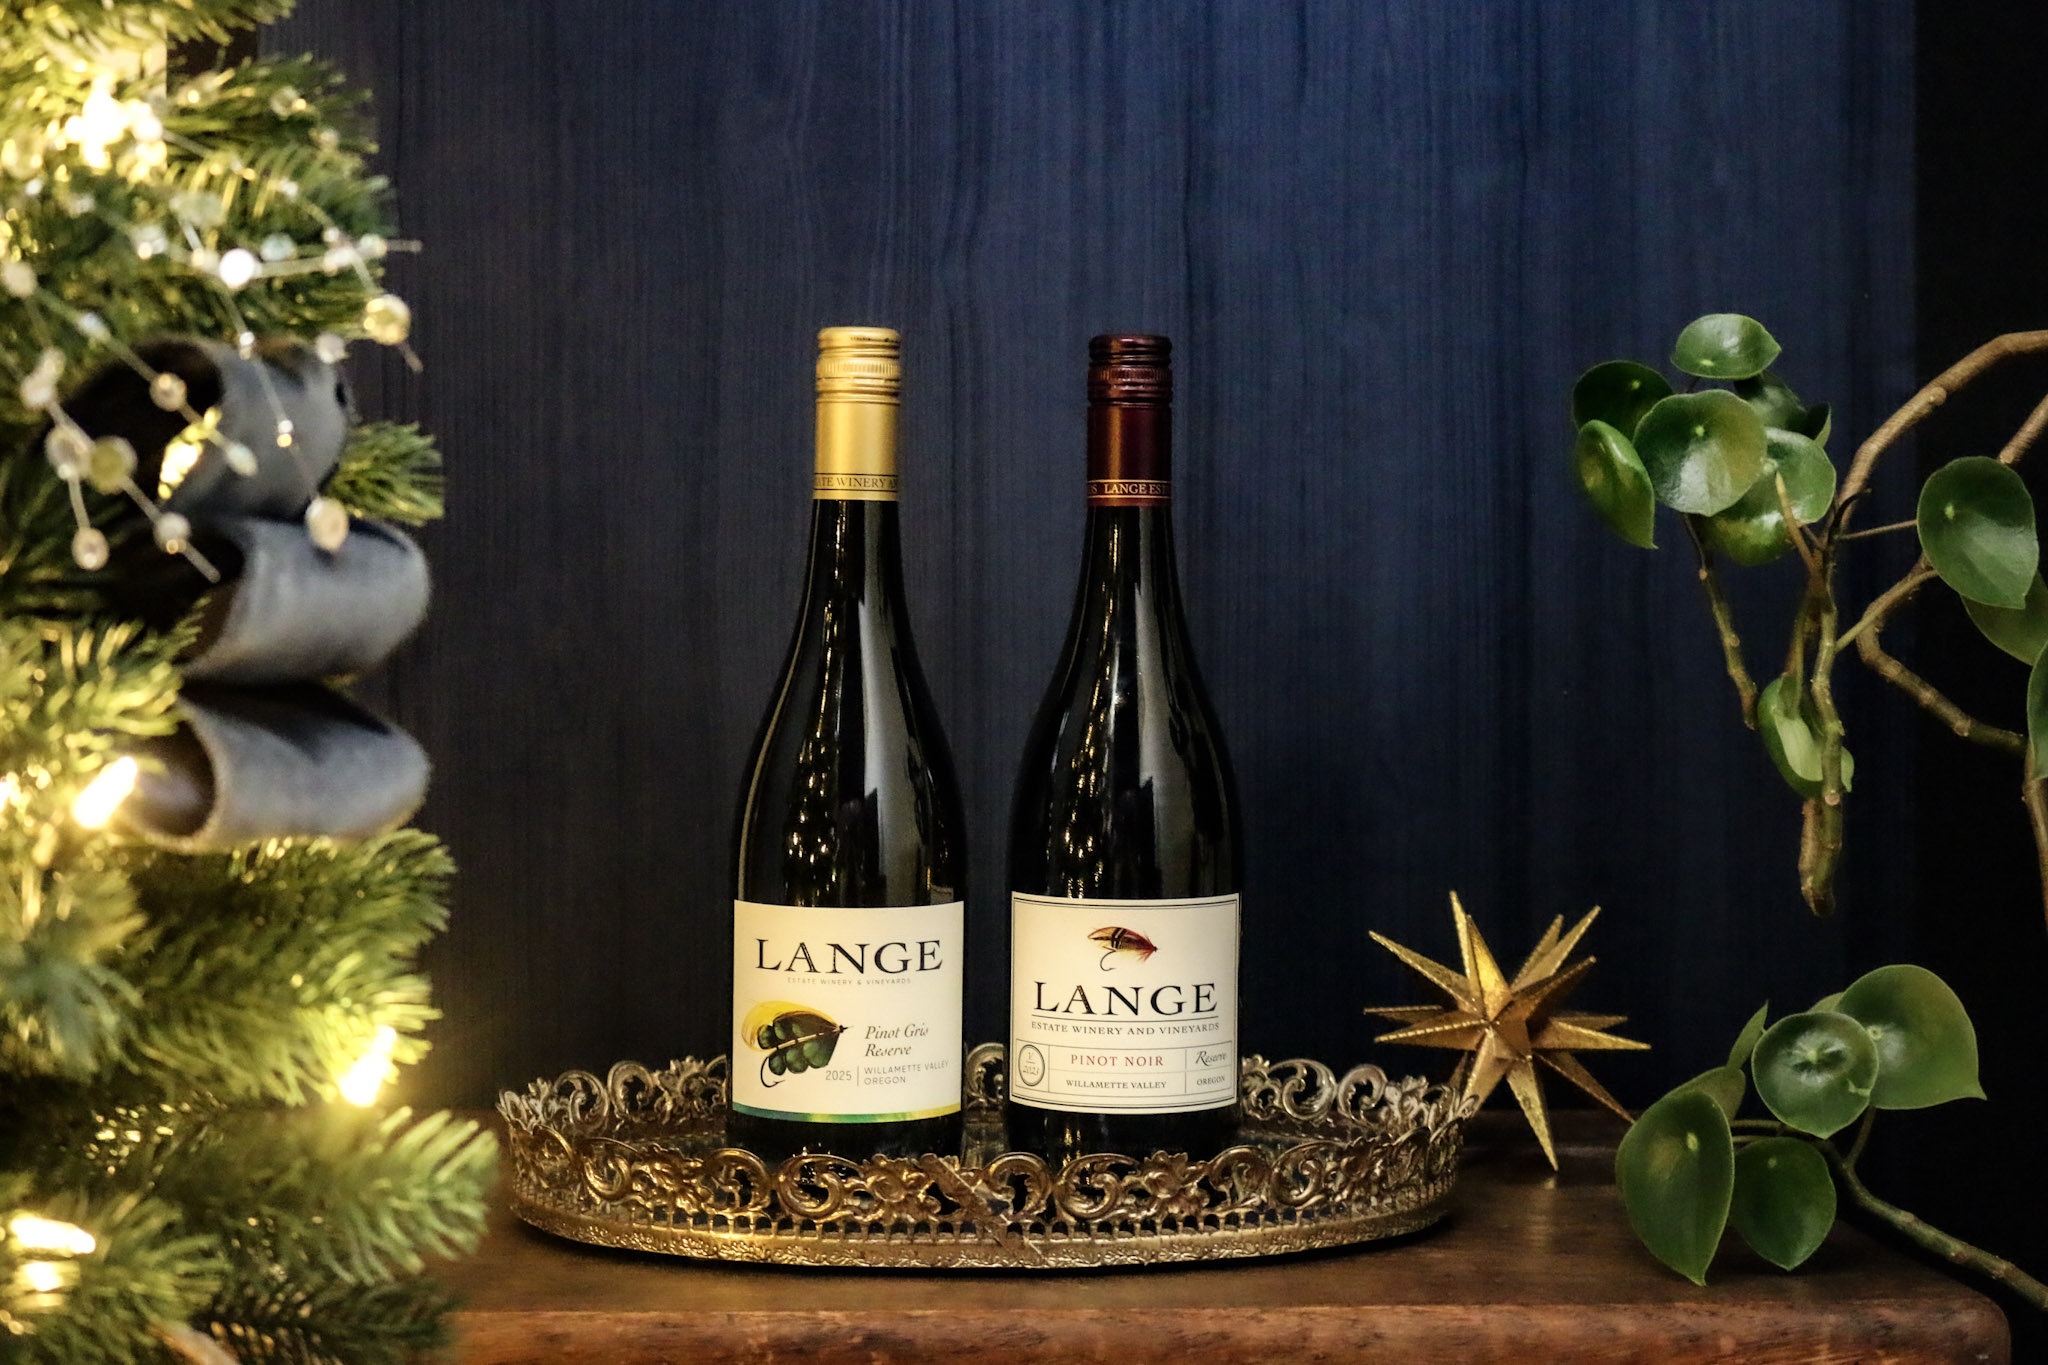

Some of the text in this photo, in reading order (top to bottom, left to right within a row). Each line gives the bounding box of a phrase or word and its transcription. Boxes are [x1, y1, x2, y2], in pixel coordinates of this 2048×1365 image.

[836, 477, 886, 488] WINERY
[1104, 483, 1148, 494] LANGE
[755, 938, 944, 974] LANGE
[787, 977, 816, 985] ESTATE
[1033, 981, 1218, 1016] LANGE
[865, 1022, 929, 1040] Pinot Gris
[1031, 1021, 1220, 1035] ESTATE WINERY AND VINEYARDS
[864, 1043, 912, 1057] Reserve
[1071, 1054, 1165, 1067] PINOT NOIR
[1195, 1050, 1228, 1067] Reserve
[864, 1060, 949, 1074] WILLAMETTE VALLEY
[825, 1070, 852, 1081] 2025
[864, 1076, 906, 1086] OREGON
[1196, 1075, 1226, 1086] OREGON
[1066, 1079, 1167, 1089] WILLAMETTE VALLEY
